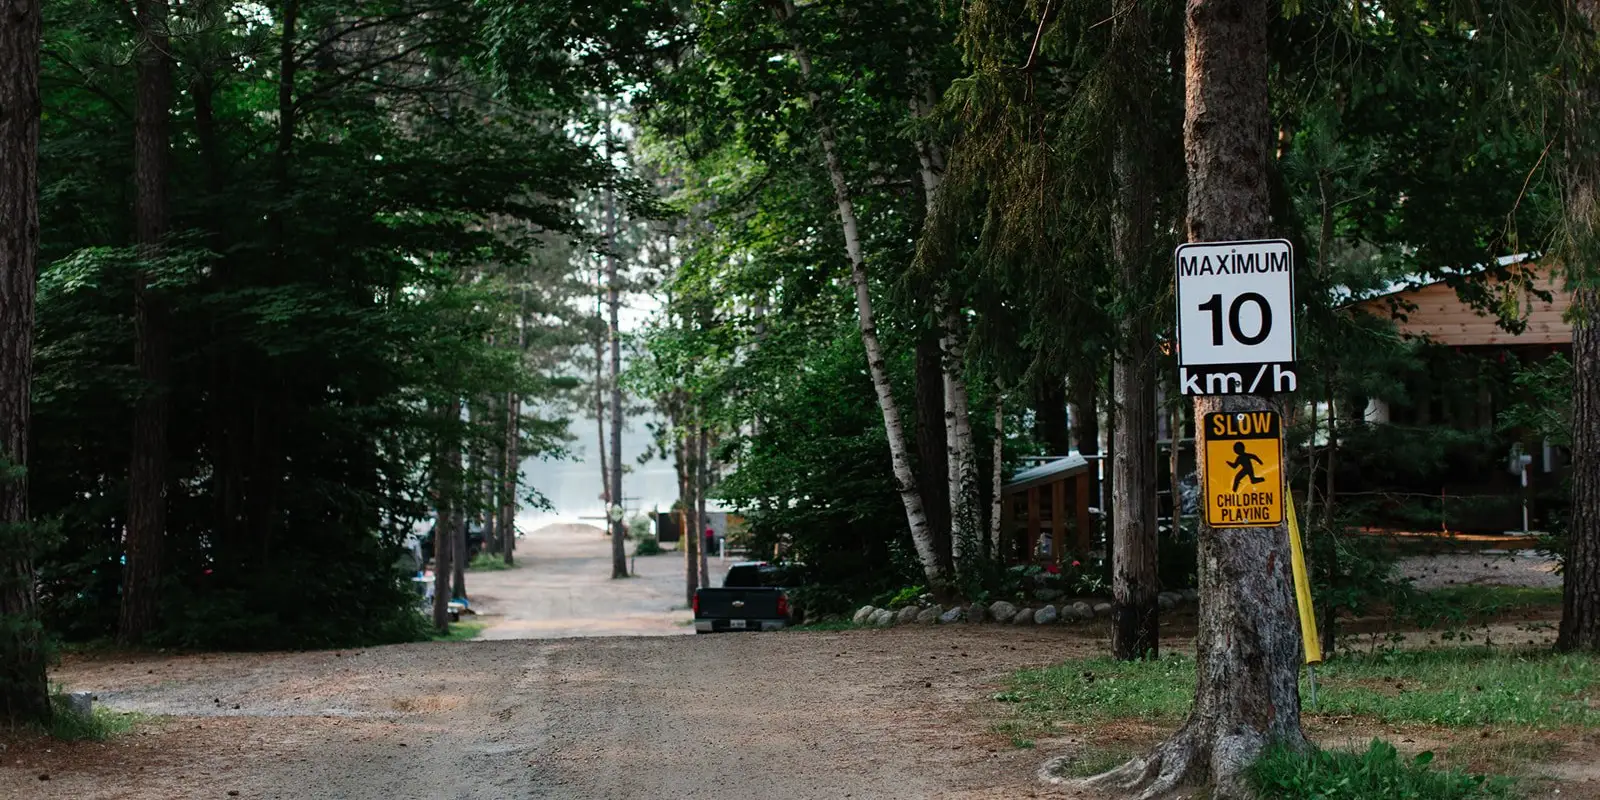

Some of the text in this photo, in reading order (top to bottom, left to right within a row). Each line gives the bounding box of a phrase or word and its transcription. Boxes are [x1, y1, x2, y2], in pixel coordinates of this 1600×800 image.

[1180, 252, 1288, 276] MAXIMUM
[1198, 292, 1272, 346] 10
[1180, 364, 1296, 395] km/h
[1213, 412, 1271, 436] SLOW
[1217, 492, 1273, 508] CHILDREN
[1221, 506, 1269, 522] PLAYING
